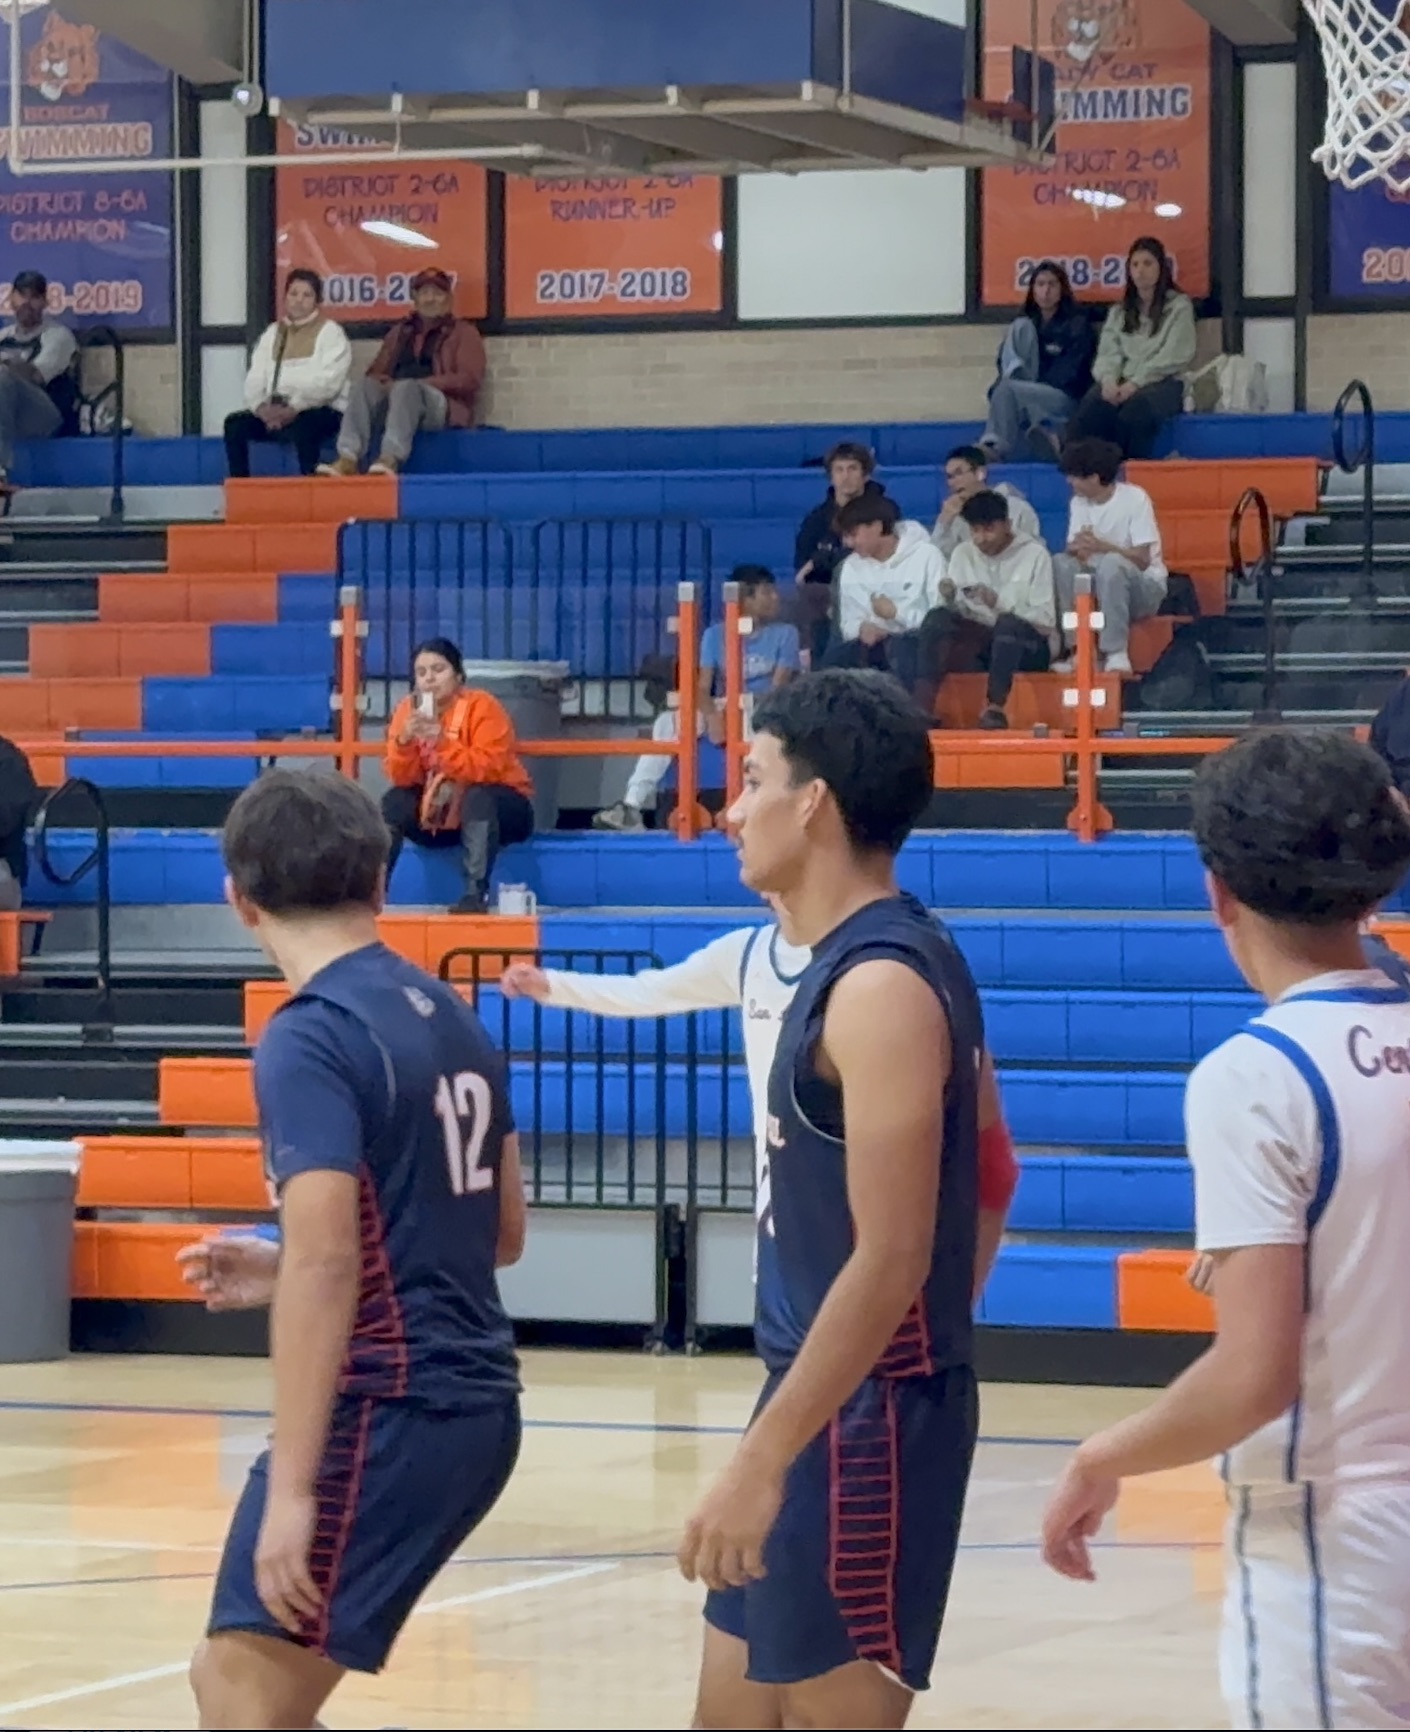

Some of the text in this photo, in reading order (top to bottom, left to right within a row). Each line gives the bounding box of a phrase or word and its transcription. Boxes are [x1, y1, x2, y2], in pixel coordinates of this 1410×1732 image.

[1111, 62, 1159, 82] CAT
[24, 103, 109, 121] BOBCAT
[303, 172, 460, 199] DISTRICT 2-6A
[0, 190, 86, 215] ISTRICT
[10, 217, 127, 243] CHAMPION
[537, 267, 692, 303] 2017-2018
[434, 1070, 494, 1197] 12
